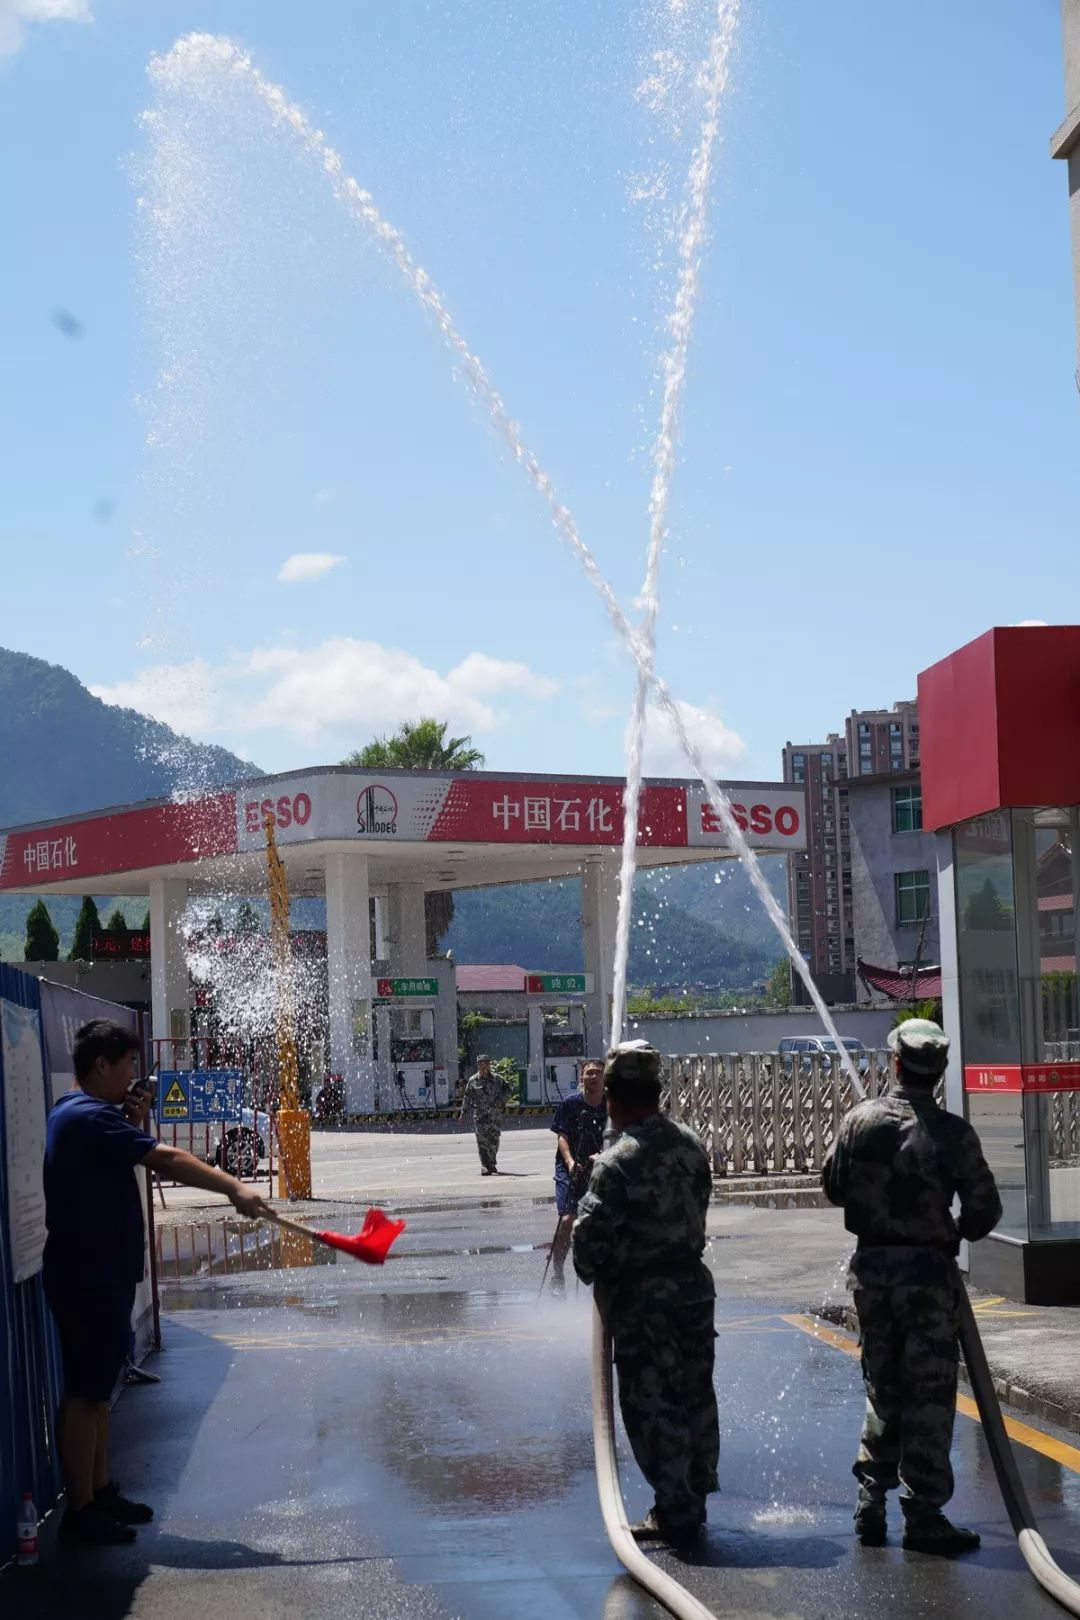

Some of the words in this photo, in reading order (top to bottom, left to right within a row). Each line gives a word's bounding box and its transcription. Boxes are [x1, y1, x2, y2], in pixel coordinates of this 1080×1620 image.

[245, 792, 312, 833] ESSO
[492, 795, 614, 832] 中国石化
[700, 803, 800, 836] ESSO
[23, 836, 78, 873] 中国石化
